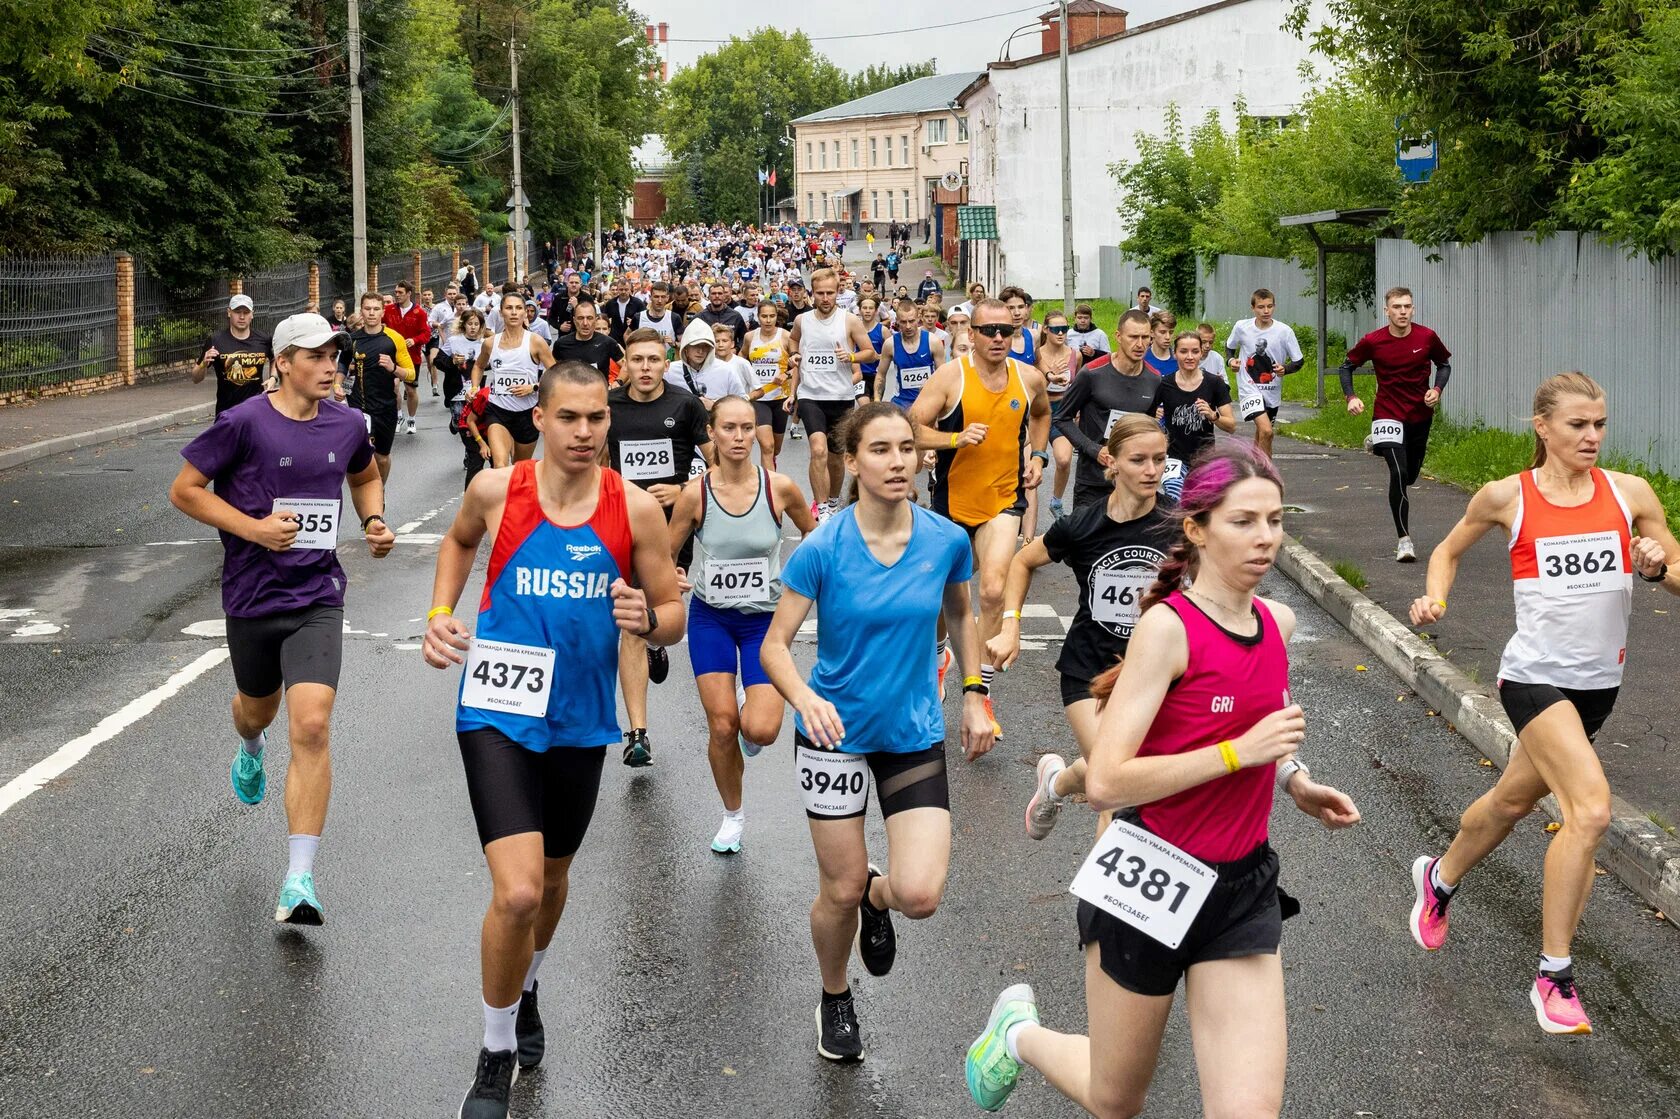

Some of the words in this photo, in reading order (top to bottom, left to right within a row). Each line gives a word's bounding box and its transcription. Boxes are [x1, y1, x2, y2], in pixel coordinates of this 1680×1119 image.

[808, 356, 834, 364] 4283
[498, 378, 526, 386] 4052
[904, 372, 928, 382] 4264
[1242, 398, 1261, 412] 4099
[1374, 426, 1402, 436] 4409
[624, 450, 670, 466] 4928
[690, 466, 704, 475] 85
[292, 514, 332, 532] 855
[566, 544, 602, 552] Reebok
[1546, 550, 1616, 578] 3862
[516, 566, 608, 598] RUSSIA
[710, 572, 764, 590] 4075
[1101, 586, 1144, 606] 461
[472, 660, 544, 693] 4373
[487, 698, 522, 706] #БОКСЗАБЕГ
[1211, 696, 1234, 713] GRi
[802, 752, 823, 762] КОМАНДА
[800, 768, 864, 796] 3940
[1118, 826, 1148, 844] КОМАНДА
[1148, 840, 1170, 856] УМАРА
[1171, 854, 1205, 877] КРЕМЛЕВА
[1096, 846, 1190, 914] 4381
[1103, 894, 1150, 922] #БОКСЗАБЕГ
